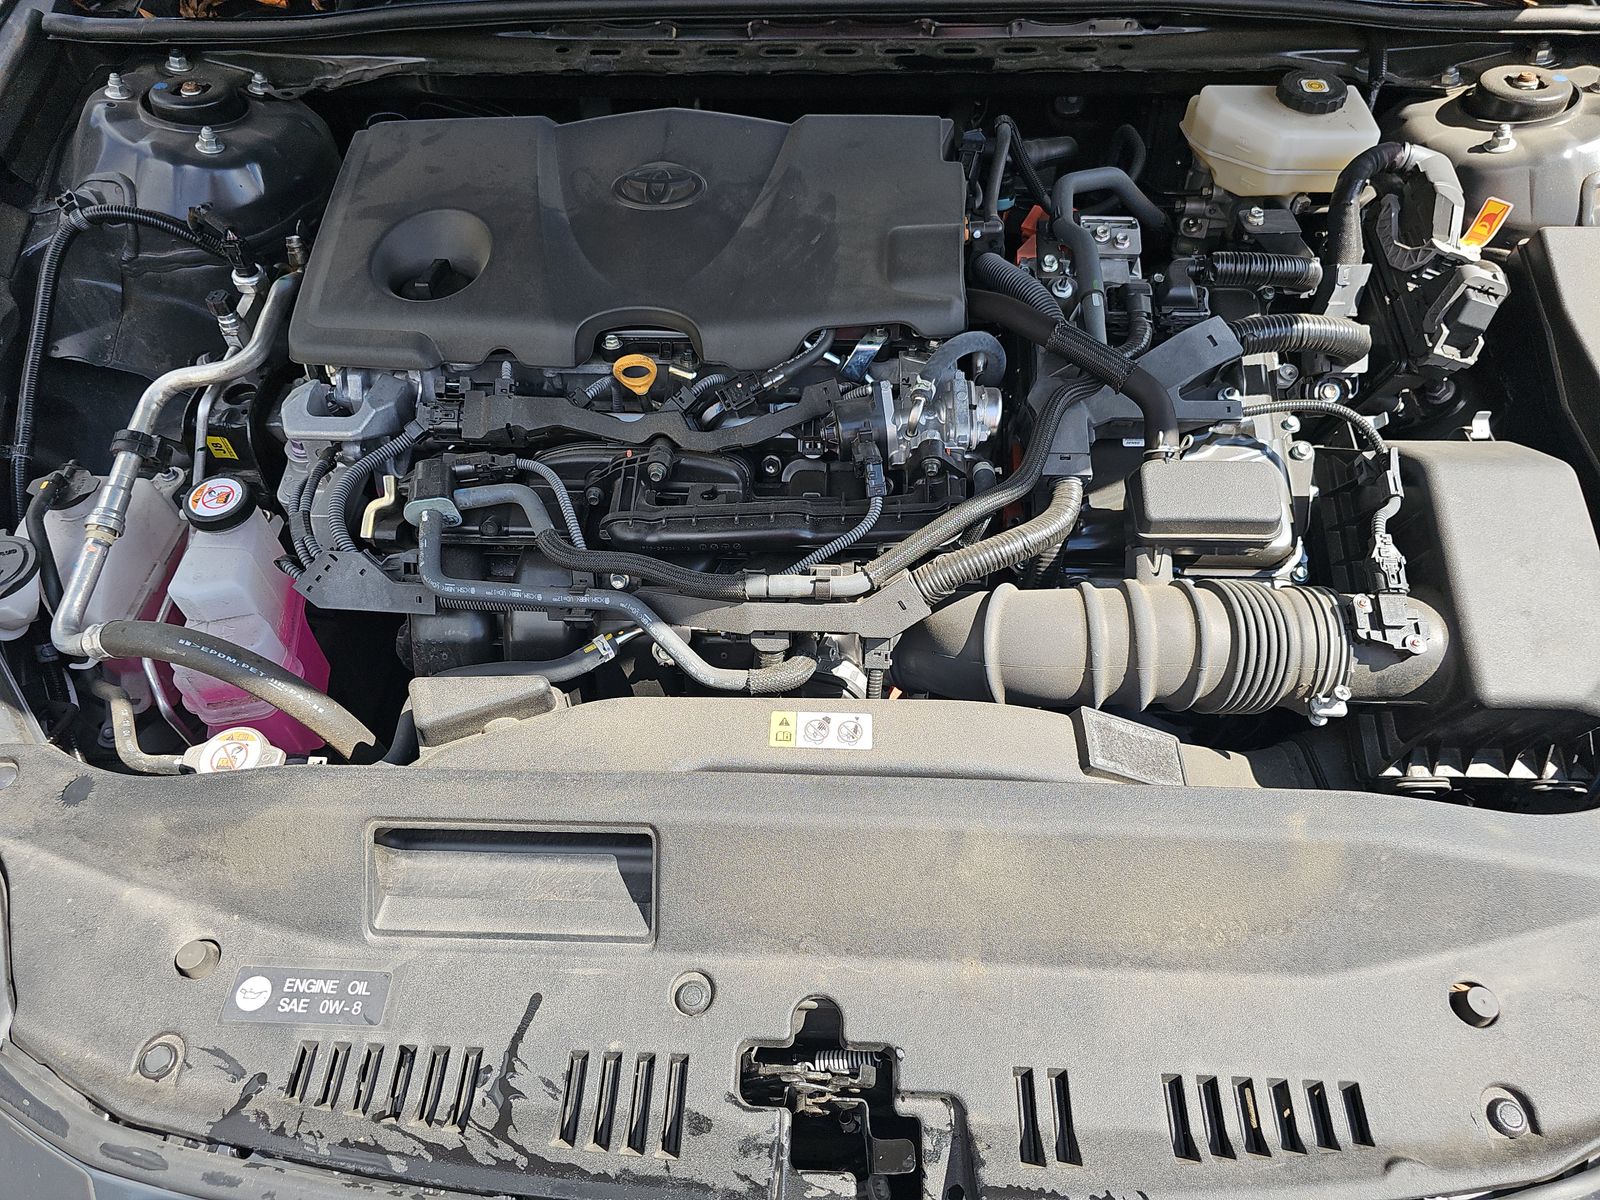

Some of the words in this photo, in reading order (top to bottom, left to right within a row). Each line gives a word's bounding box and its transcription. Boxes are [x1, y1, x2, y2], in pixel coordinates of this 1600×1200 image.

[283, 978, 340, 994] ENGINE
[347, 980, 371, 996] OIL
[277, 997, 310, 1013] SAE
[319, 1000, 362, 1015] 0W-8
